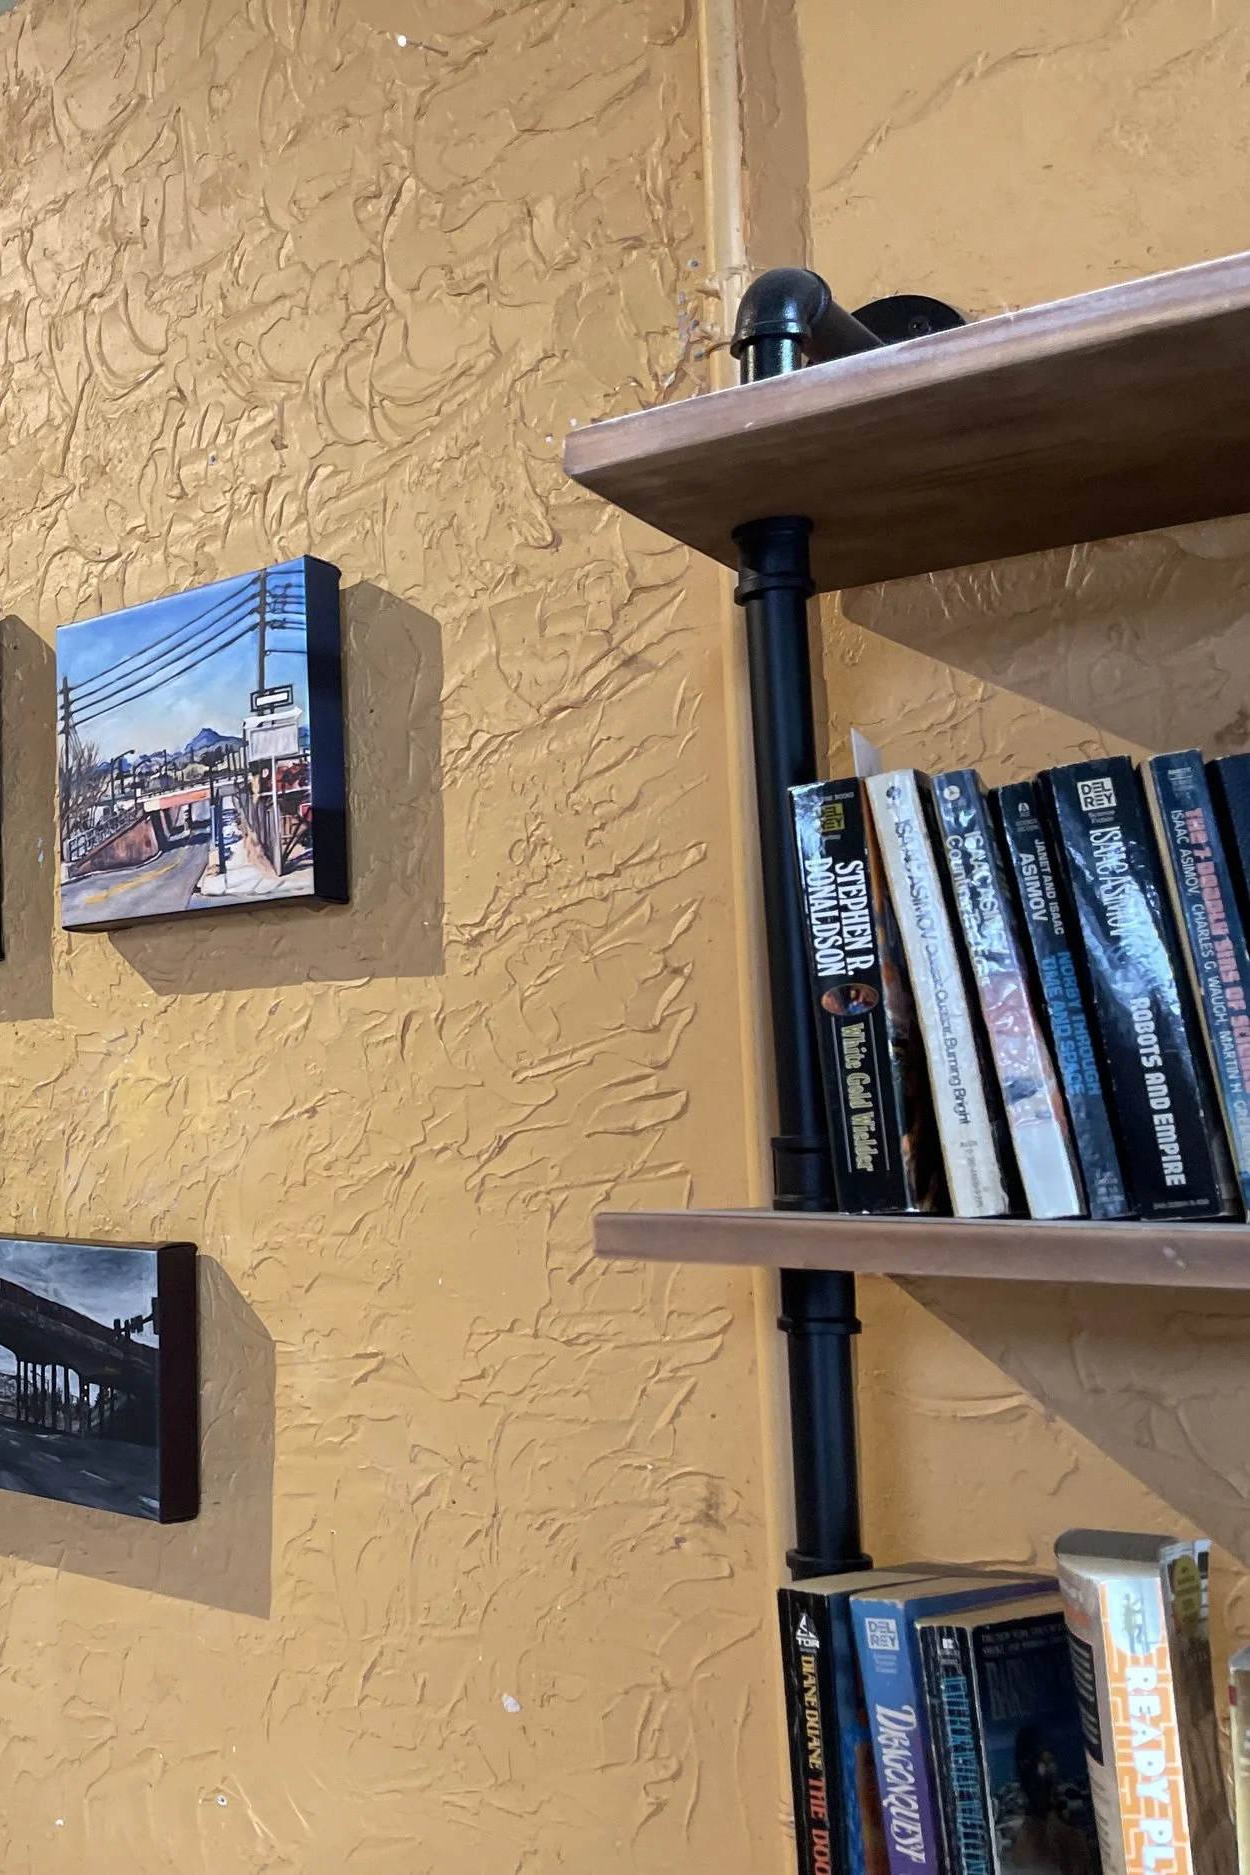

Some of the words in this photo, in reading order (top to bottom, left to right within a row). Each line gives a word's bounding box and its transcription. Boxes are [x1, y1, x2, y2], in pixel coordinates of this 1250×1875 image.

[1081, 781, 1113, 796] DEL
[1083, 793, 1114, 808] REY
[964, 830, 993, 886] ISAAC
[1034, 838, 1049, 873] JANET
[1089, 825, 1129, 880] ISAAC
[1193, 846, 1212, 860] 7
[835, 860, 874, 951] STEPHEN
[1019, 852, 1049, 922] ASIMOV
[1042, 874, 1057, 899] AND
[1098, 875, 1136, 938] ASIMOV
[804, 856, 847, 977] DONALDSON
[1049, 899, 1065, 935] ISAAC
[846, 954, 875, 976] R.
[1170, 809, 1190, 845] ISAAC
[1191, 902, 1215, 958] CHARLES
[1218, 1030, 1240, 1082] MARTIN
[908, 875, 937, 939] ASIMOV
[943, 1037, 962, 1086] Burning
[953, 1087, 972, 1125] Bright
[1050, 1000, 1073, 1037] AND
[1056, 951, 1083, 1010] NORBY
[1071, 1010, 1101, 1096] THROUGH
[841, 1022, 867, 1069] White
[1129, 996, 1163, 1068] ROBOTS
[846, 1073, 873, 1110] Gold
[1059, 1039, 1086, 1096] SPACE
[1144, 1072, 1172, 1111] AND
[851, 1111, 879, 1173] Wielder
[1152, 1112, 1187, 1187] EMPIRE
[796, 1635, 820, 1650] TOR
[867, 1620, 896, 1634] DEL
[870, 1632, 898, 1648] REY
[801, 1655, 819, 1708] DIANE
[805, 1707, 825, 1771] DUANE
[1124, 1665, 1172, 1804] READY
[808, 1776, 828, 1819] THE
[875, 1703, 927, 1865] DRAGONQUEST
[1137, 1819, 1177, 1875] PL
